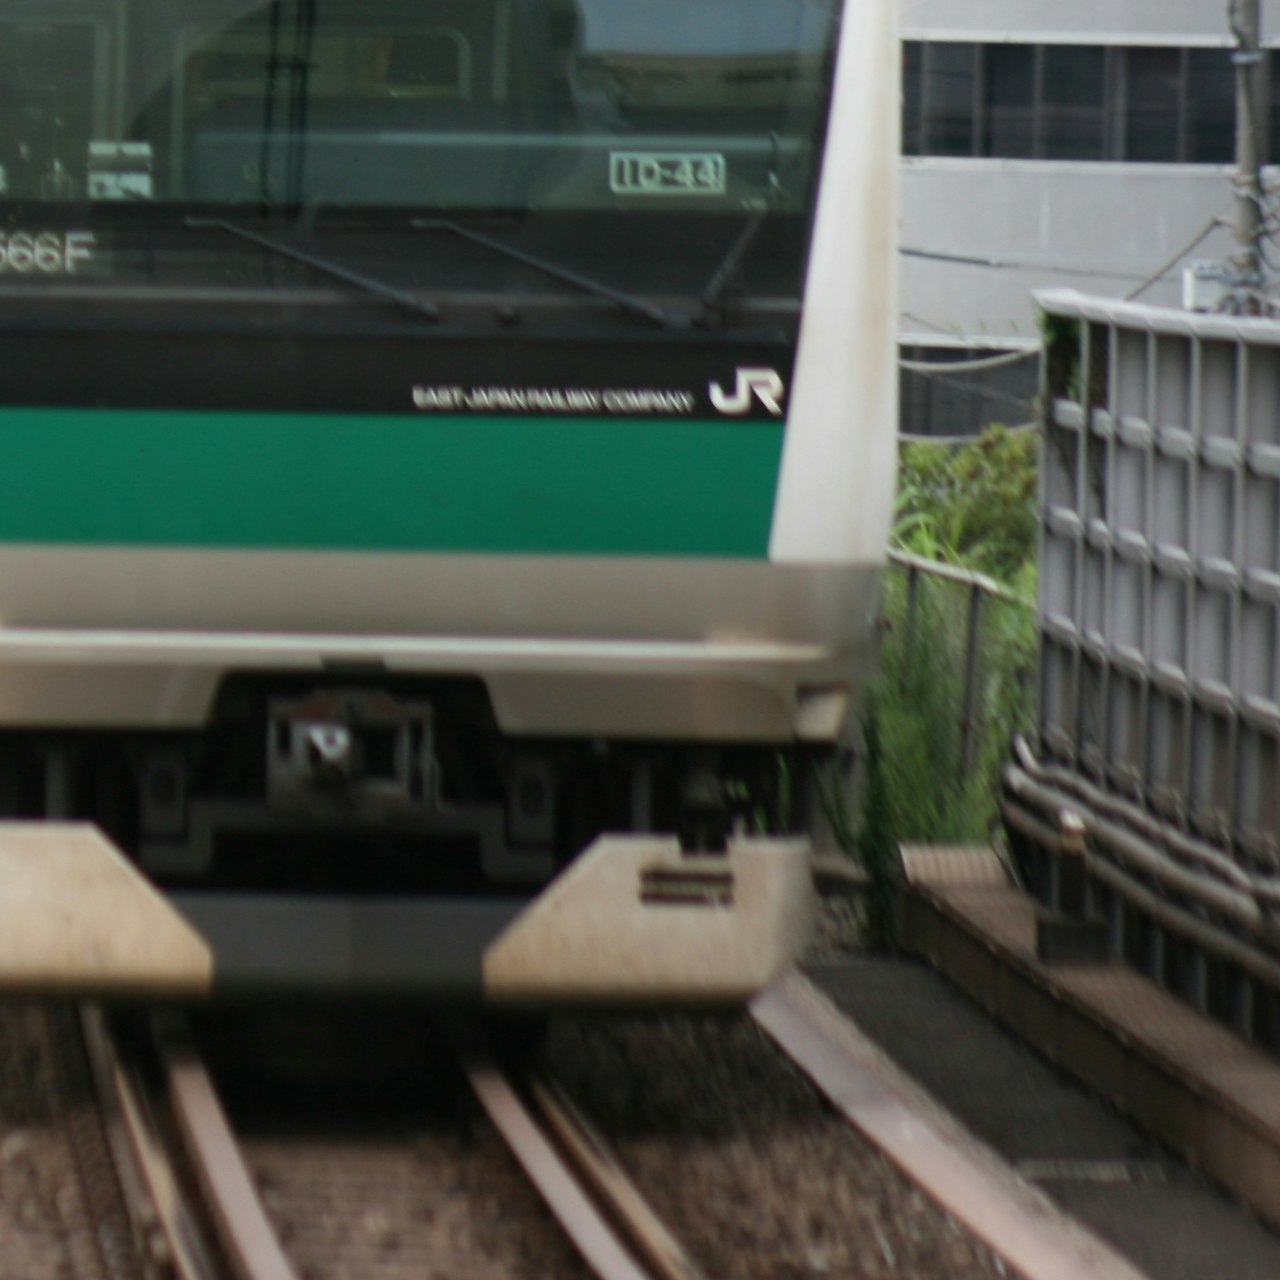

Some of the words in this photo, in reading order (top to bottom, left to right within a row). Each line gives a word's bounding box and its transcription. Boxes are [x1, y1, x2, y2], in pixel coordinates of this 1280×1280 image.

[412, 385, 462, 410] EAST
[463, 386, 527, 411] JAPAN
[528, 388, 601, 413] RAILWAY
[603, 390, 694, 414] COMPANY
[709, 368, 783, 415] JR
